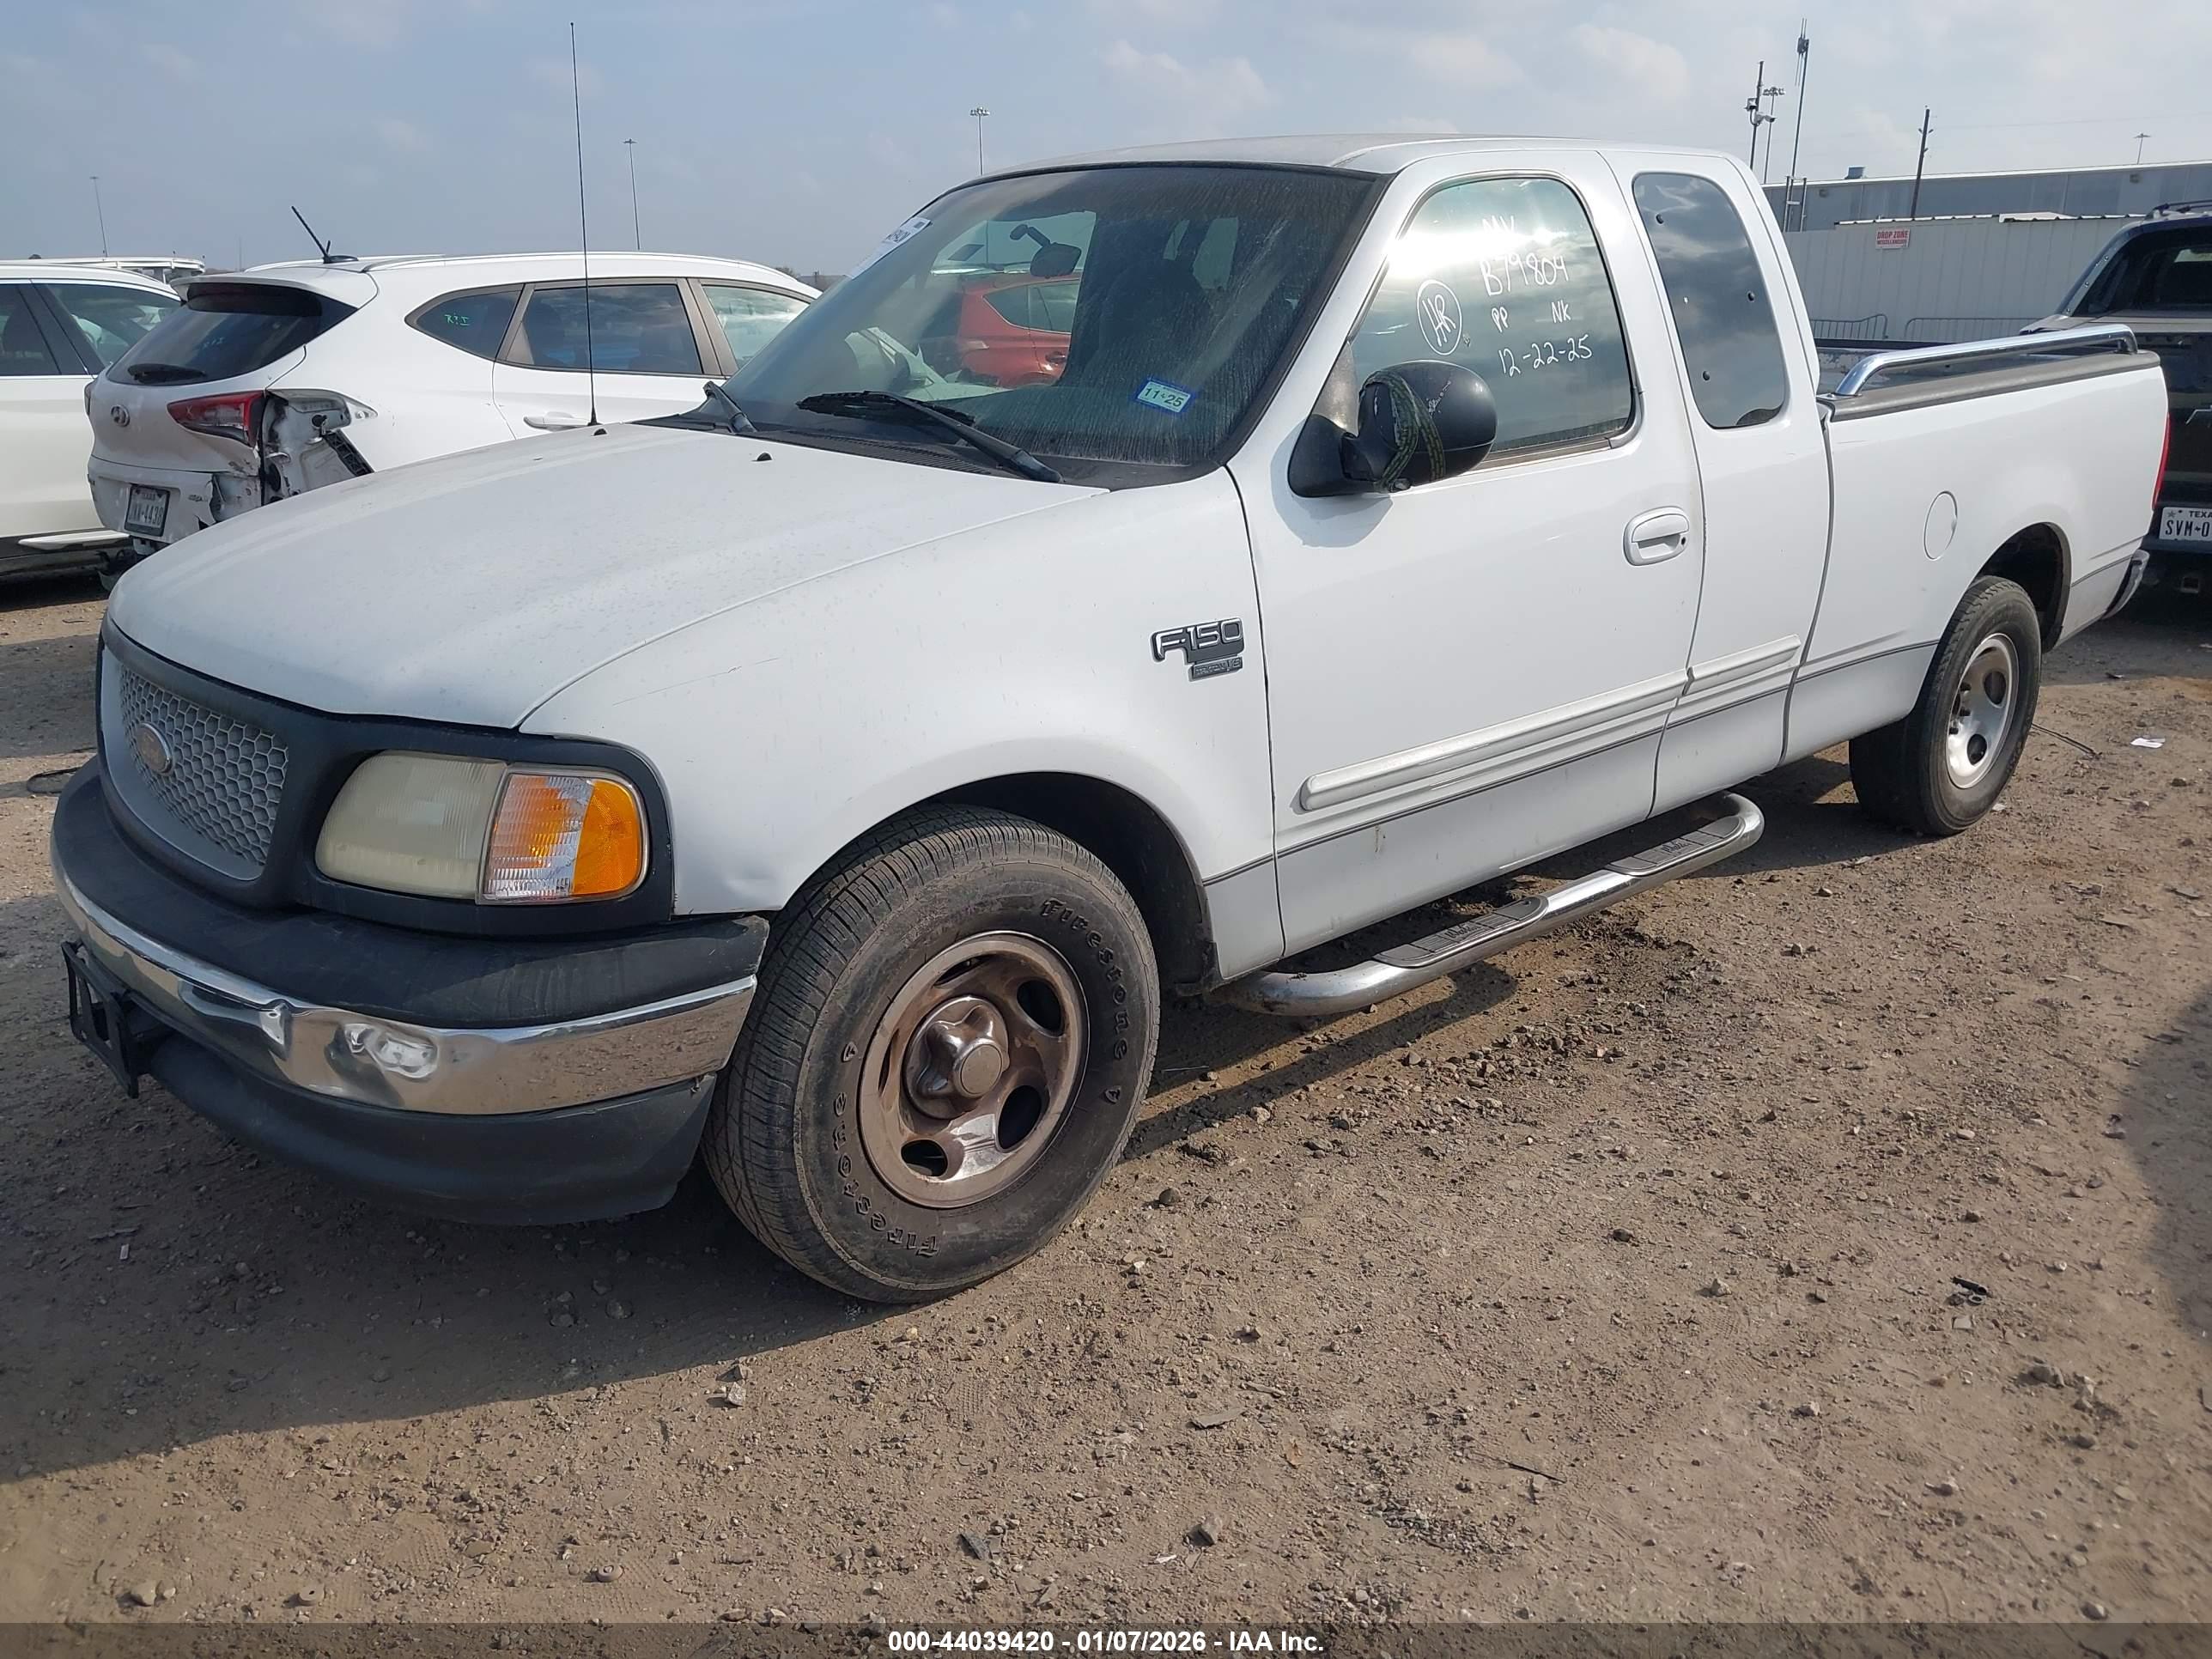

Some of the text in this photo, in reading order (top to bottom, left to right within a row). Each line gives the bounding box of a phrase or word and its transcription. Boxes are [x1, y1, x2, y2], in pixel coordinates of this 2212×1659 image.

[1877, 229, 1909, 240] DROP ZONE
[1498, 334, 1593, 378] 12-22-25
[1040, 896, 1131, 1060] Firestone
[833, 1091, 939, 1258] Firestone
